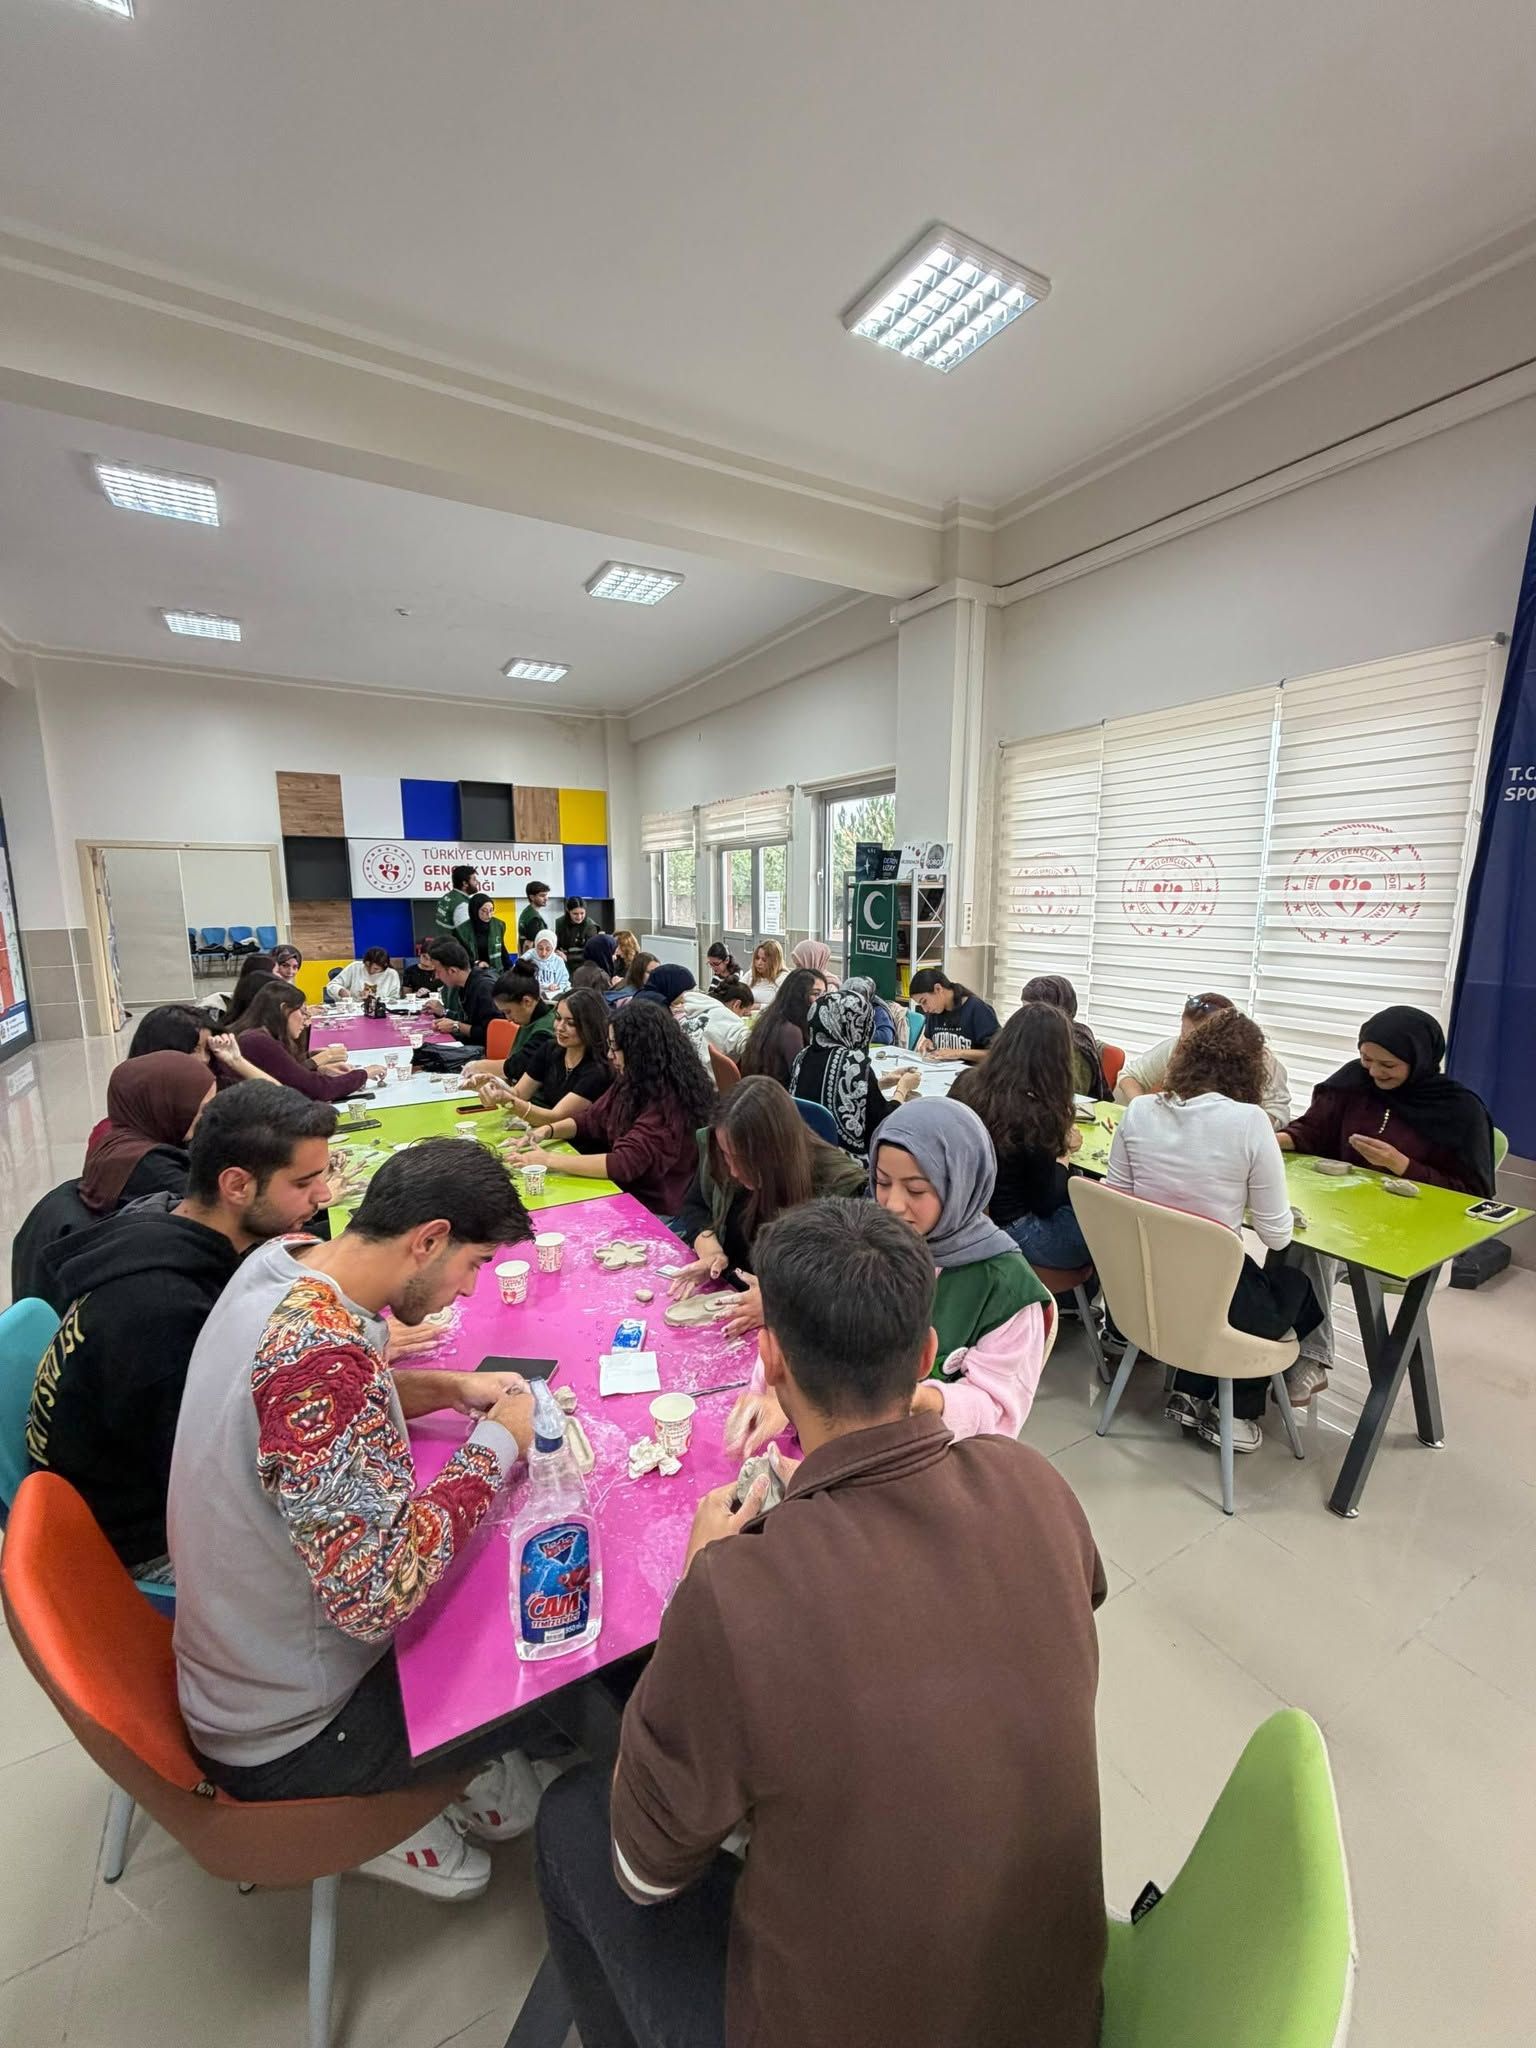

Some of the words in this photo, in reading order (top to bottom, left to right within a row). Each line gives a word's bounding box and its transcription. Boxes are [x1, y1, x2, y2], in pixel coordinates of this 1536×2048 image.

[422, 847, 473, 860] TÜRKİYE
[475, 849, 554, 862] CUMHURİYETİ
[423, 864, 479, 876] GENK
[481, 866, 497, 876] VE
[499, 865, 532, 876] SPOR
[424, 880, 495, 891] BAKIĞI
[528, 1591, 580, 1621] CAM
